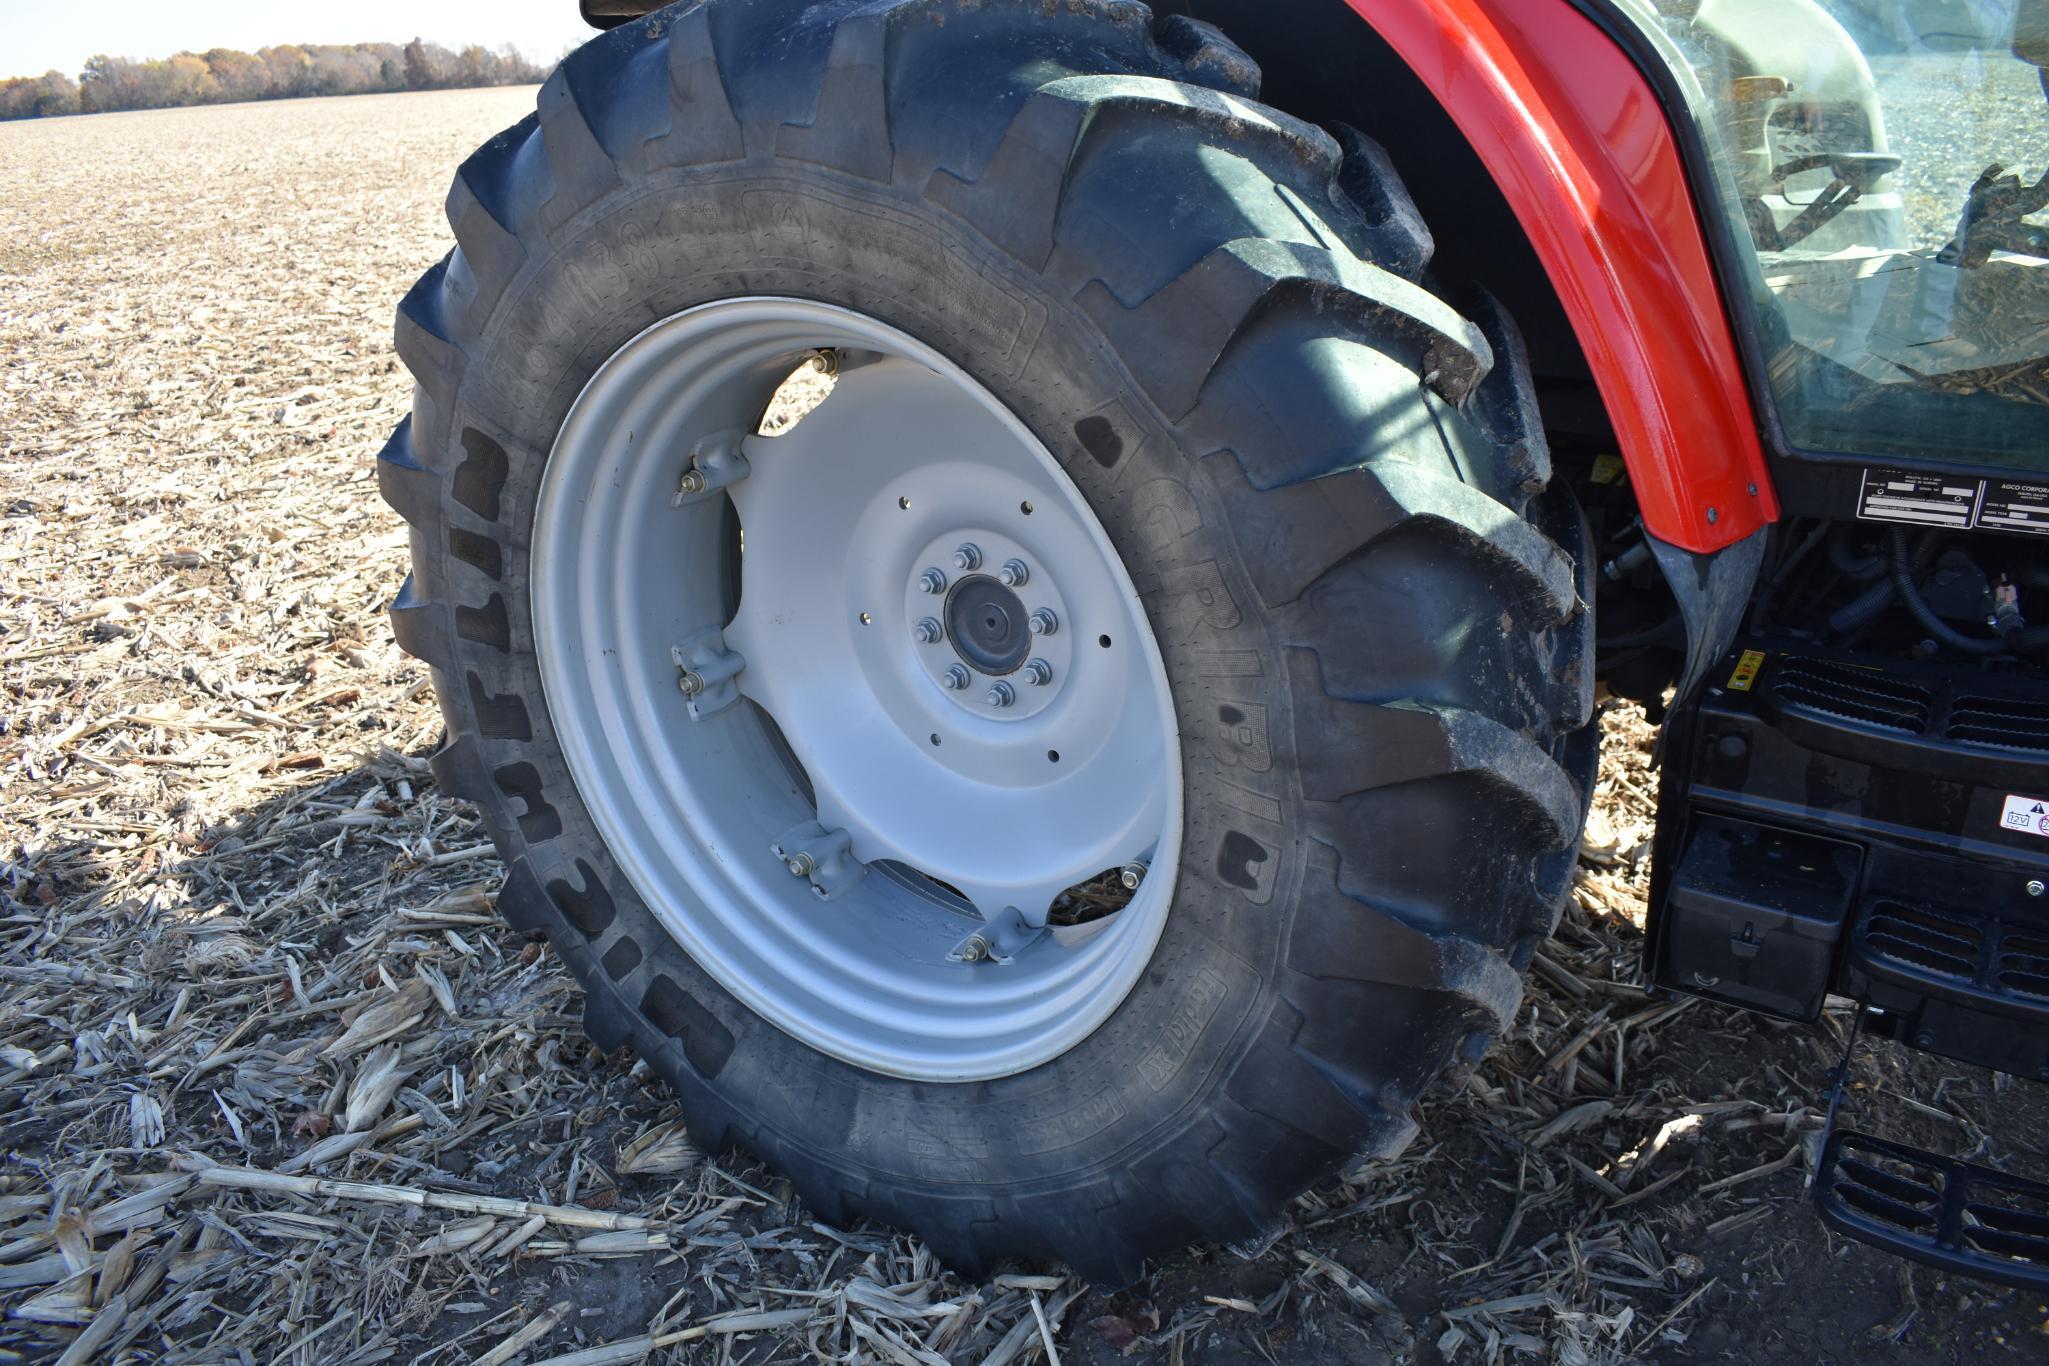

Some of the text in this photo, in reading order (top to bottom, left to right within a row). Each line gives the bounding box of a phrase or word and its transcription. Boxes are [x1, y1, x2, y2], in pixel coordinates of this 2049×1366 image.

[448, 423, 736, 1082] MICHELIN
[1072, 398, 1284, 906] AGRIBIB
[2009, 814, 2027, 824] 12V
